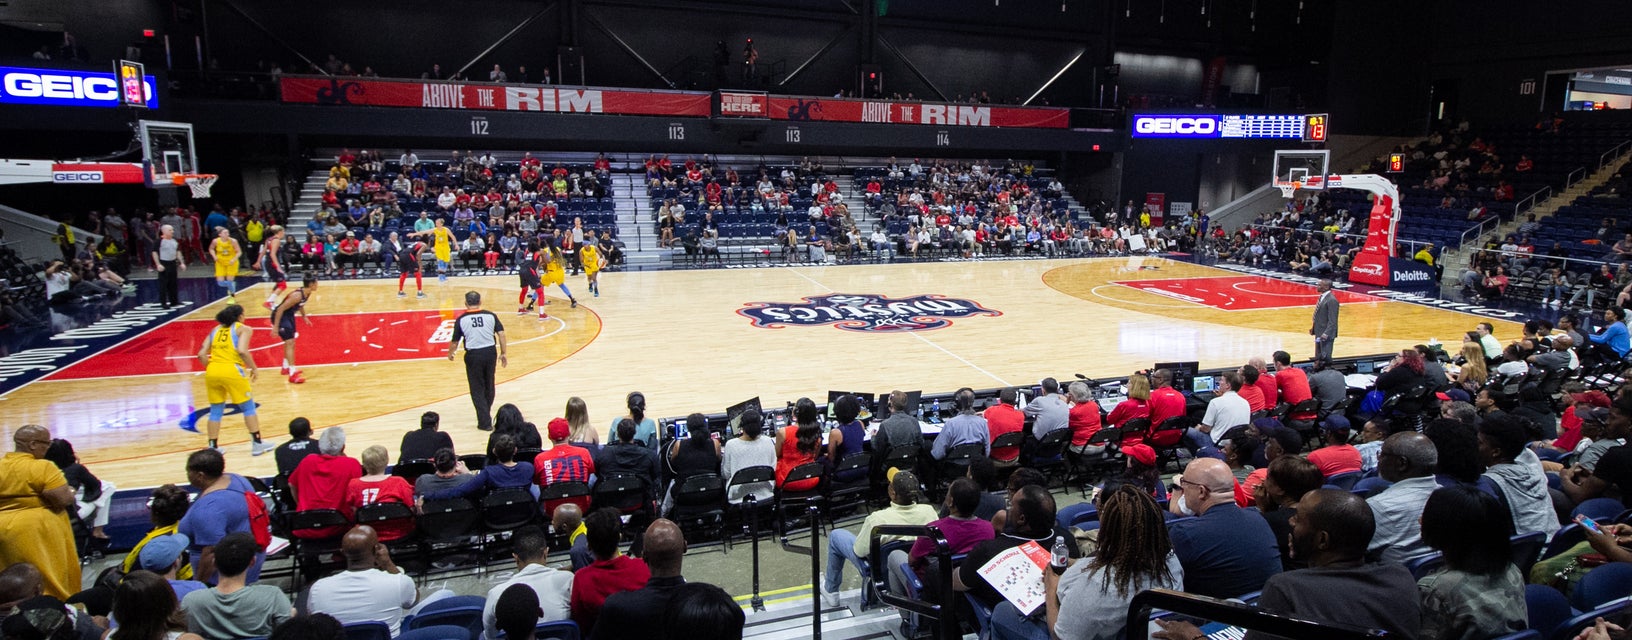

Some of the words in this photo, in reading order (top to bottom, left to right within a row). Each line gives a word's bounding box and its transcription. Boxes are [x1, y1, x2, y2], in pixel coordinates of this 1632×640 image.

[1520, 82, 1536, 95] 101
[422, 84, 466, 108] ABOVE
[477, 89, 495, 107] THE
[505, 87, 603, 113] RIM
[721, 102, 761, 112] HERE
[861, 102, 893, 123] ABOVE
[901, 106, 914, 122] THE
[921, 104, 991, 126] RIM
[471, 121, 489, 135] 112
[1136, 118, 1216, 134] GEICO
[1312, 125, 1324, 138] 13
[669, 126, 685, 140] 113
[786, 130, 800, 142] 113
[937, 134, 949, 146] 114
[54, 173, 102, 181] GEICO
[471, 316, 485, 328] 39
[217, 329, 229, 342] 15
[552, 455, 584, 482] 20
[362, 488, 380, 506] 17
